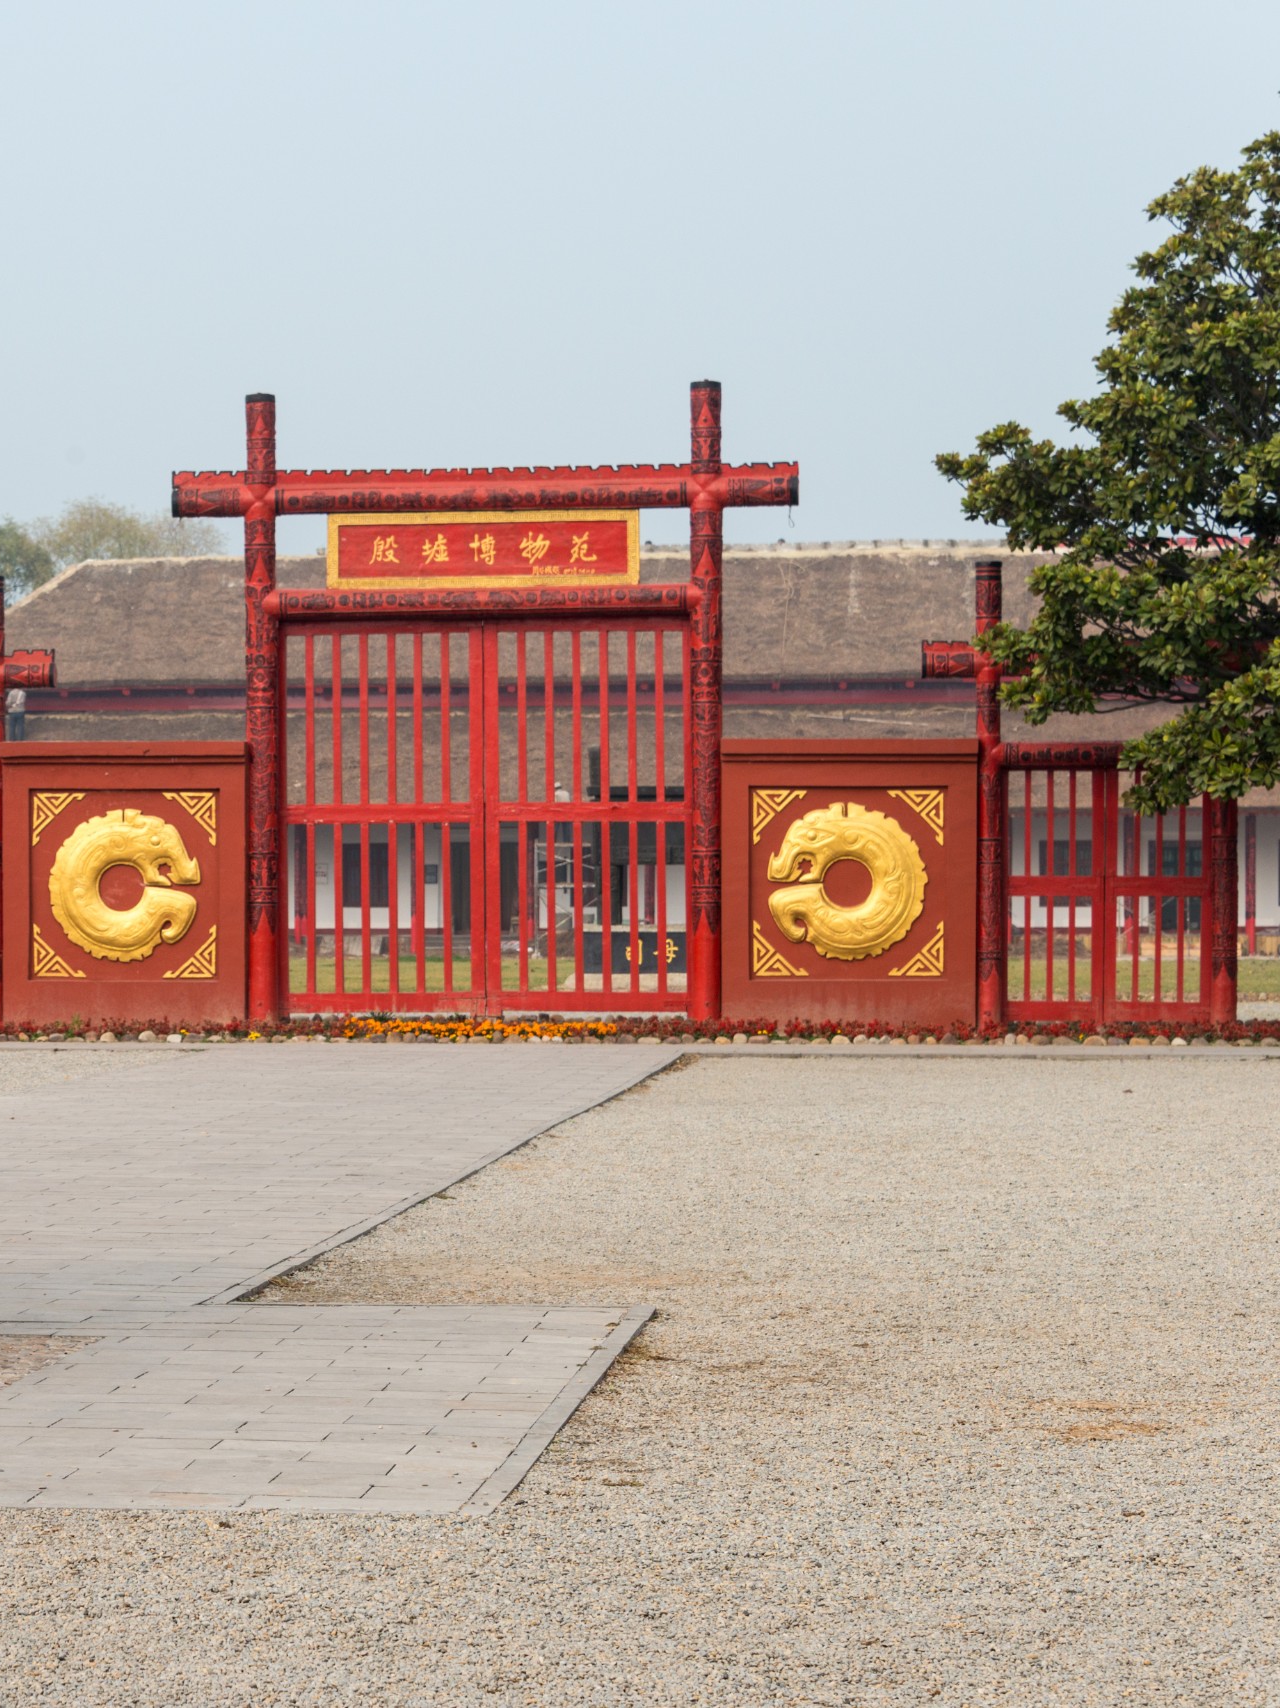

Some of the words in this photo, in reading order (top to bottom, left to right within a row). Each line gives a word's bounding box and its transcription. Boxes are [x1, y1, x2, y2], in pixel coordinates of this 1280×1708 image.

[369, 531, 598, 565] 殷墟博物苑
